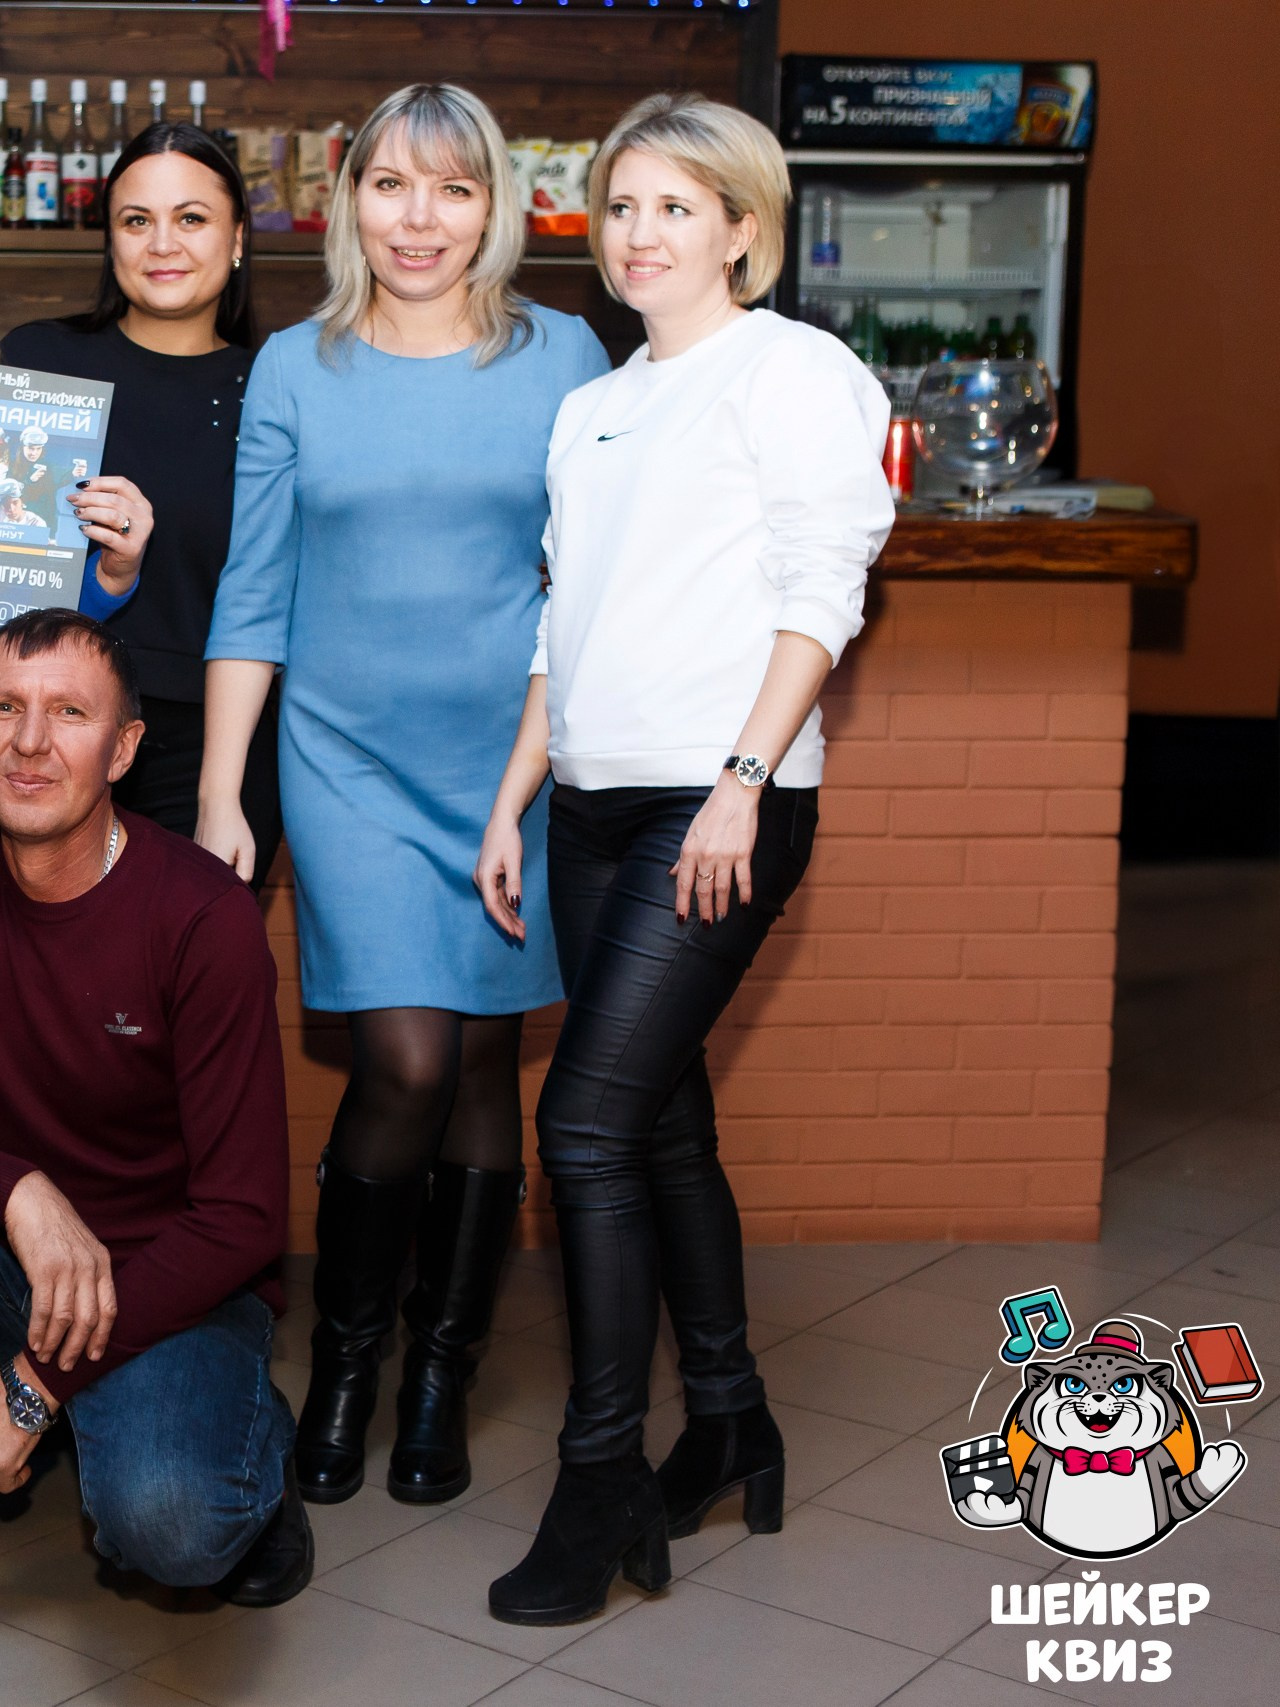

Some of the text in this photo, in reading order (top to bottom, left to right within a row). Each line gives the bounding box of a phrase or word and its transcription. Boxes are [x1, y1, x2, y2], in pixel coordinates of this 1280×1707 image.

[830, 95, 848, 125] 5
[12, 389, 106, 410] СЕРТИФИКАТ
[28, 569, 47, 588] 50
[48, 571, 63, 589] %
